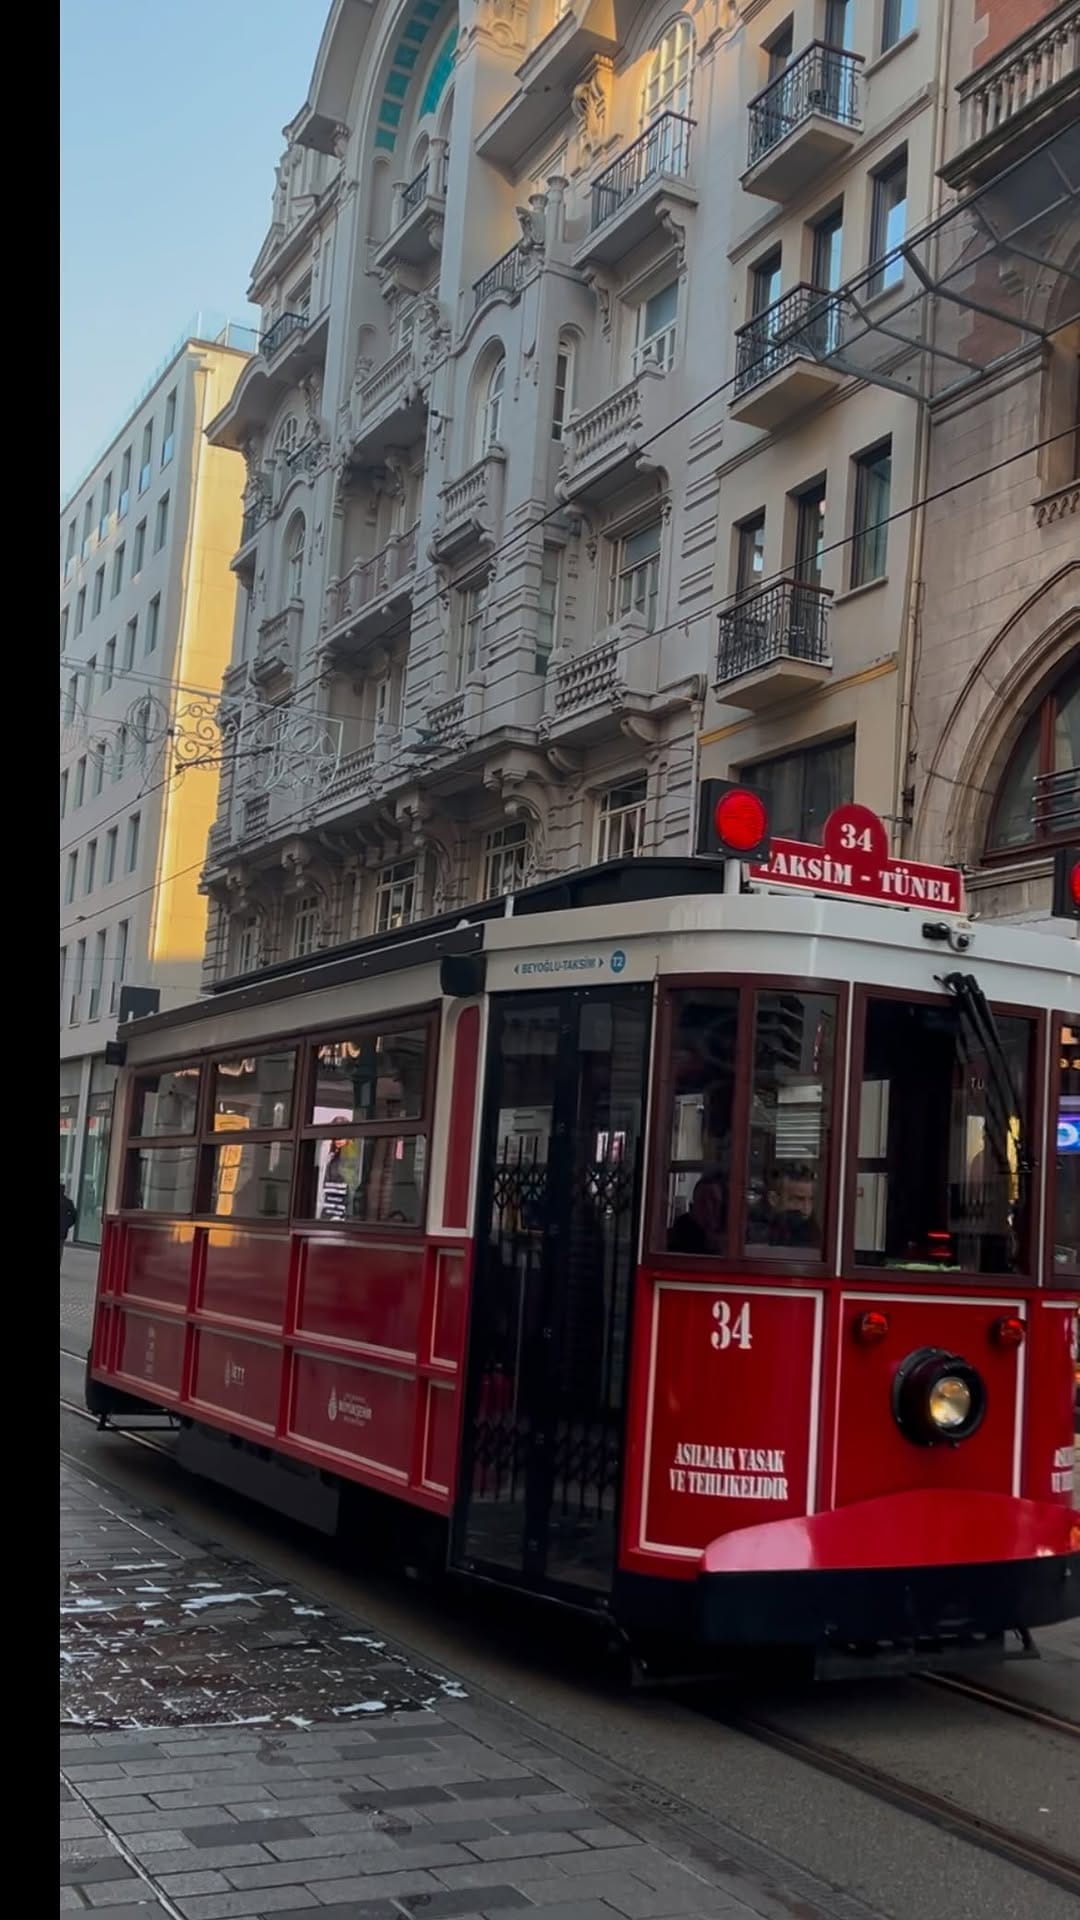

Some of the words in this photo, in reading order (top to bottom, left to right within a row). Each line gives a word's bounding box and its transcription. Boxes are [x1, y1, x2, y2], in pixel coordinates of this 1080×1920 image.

[840, 823, 873, 852] 34
[878, 867, 955, 904] TÜNEL
[711, 1300, 753, 1350] 34
[674, 1441, 736, 1470] ASILMAK
[737, 1447, 785, 1473] YASAK
[669, 1468, 686, 1493] VE
